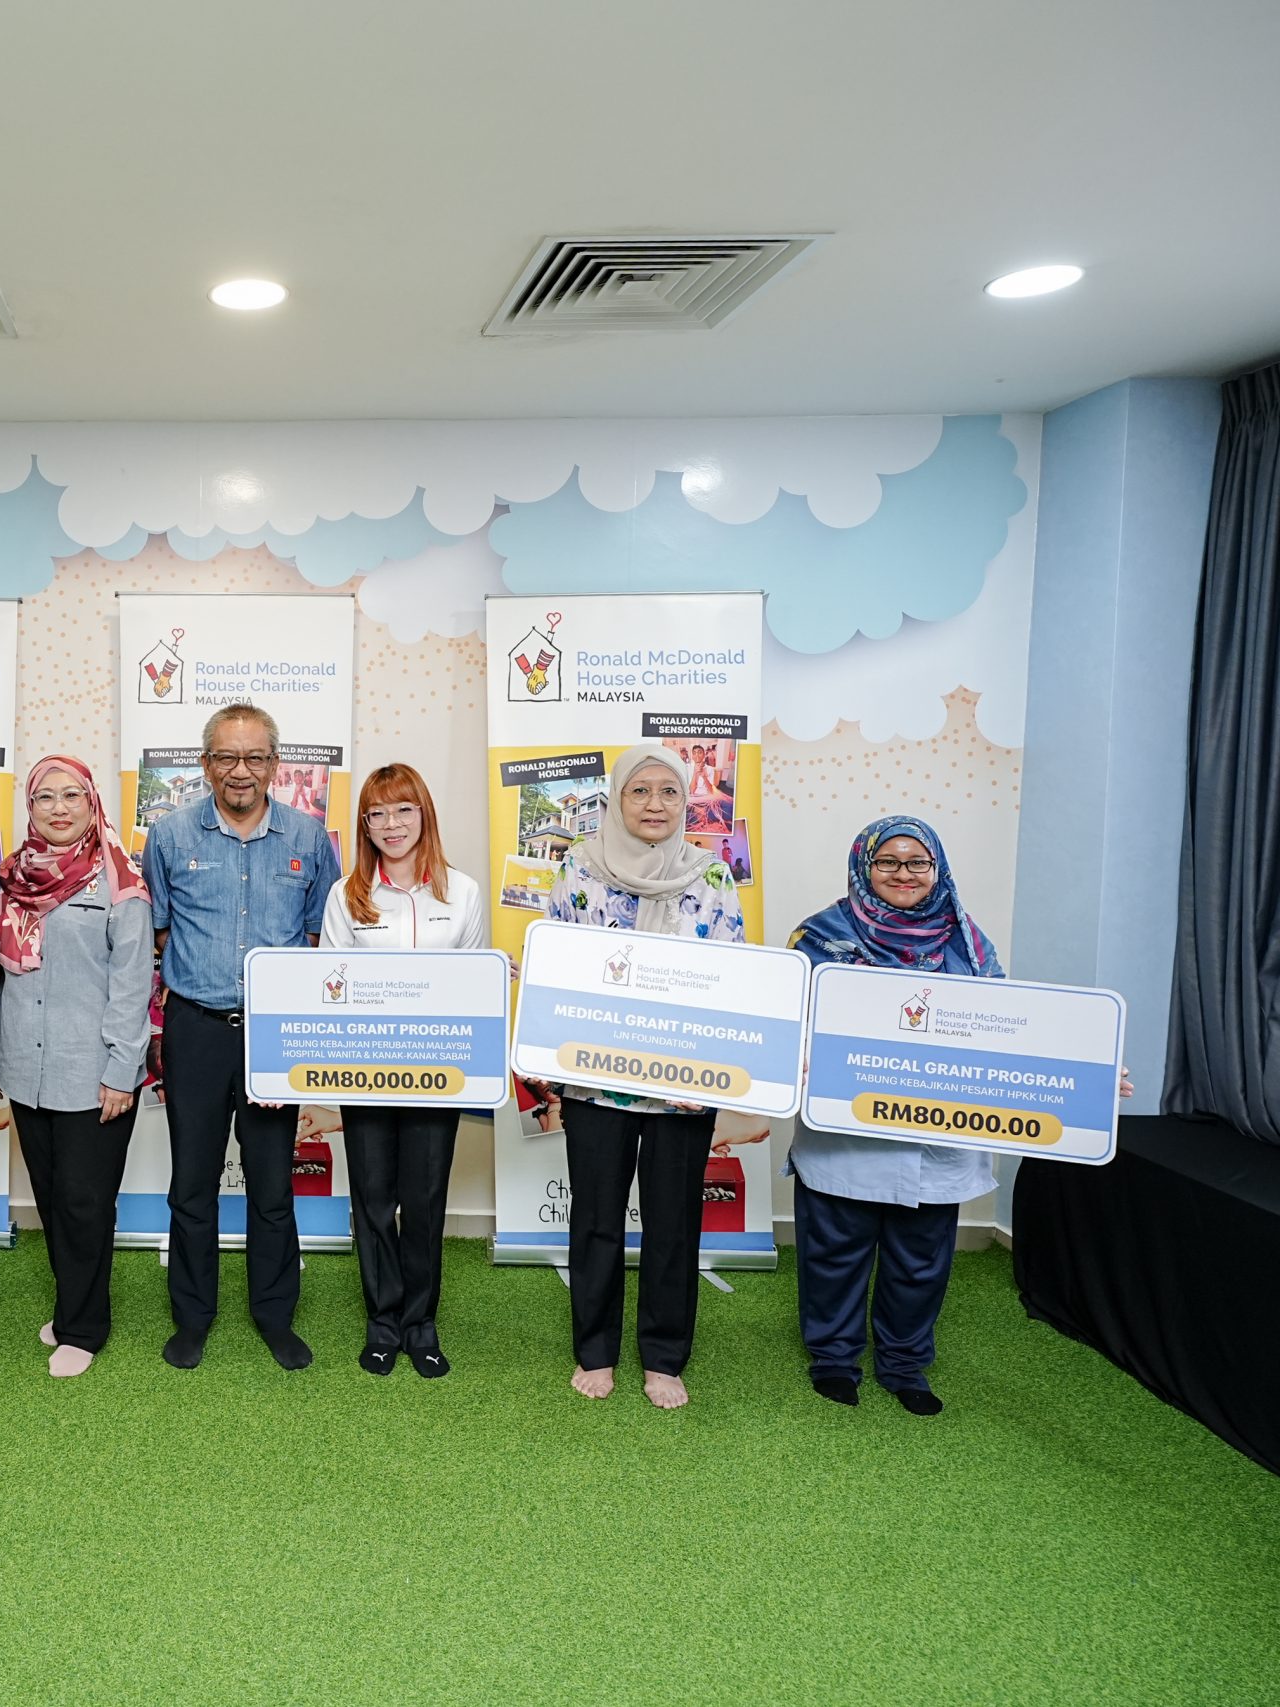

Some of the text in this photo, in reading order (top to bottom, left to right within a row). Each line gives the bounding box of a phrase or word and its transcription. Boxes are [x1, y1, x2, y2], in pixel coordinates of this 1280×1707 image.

[576, 648, 745, 667] Ronald McDonald
[195, 661, 336, 676] Ronald McDonald
[577, 669, 727, 686] House Charities
[195, 678, 323, 692] House Charities
[195, 695, 254, 707] MALAYSIA
[577, 691, 645, 702] MALAYSIA
[649, 716, 741, 726] RONALD McDONALD
[658, 725, 732, 735] SENSORY ROOM
[278, 753, 307, 761] ENSORY
[296, 747, 338, 756] McDONALD
[172, 757, 199, 765] HOUSE
[507, 756, 597, 774] RONALD McDONALD
[538, 767, 570, 779] HOUSE
[637, 963, 720, 982] Ronald McDonald
[352, 980, 430, 989] Ronald McDonald
[635, 982, 669, 992] MALAYSIA
[636, 973, 710, 990] House Charities
[352, 989, 423, 998] House Charities
[553, 1003, 763, 1044] MEDICAL GRANT PROGRAM
[936, 1008, 1027, 1026] Ronald McDonald
[280, 1022, 472, 1036] MEDICAL GRANT PROGRAM
[934, 1028, 972, 1038] MALAYSIA
[935, 1018, 1018, 1035] House Charities
[281, 1039, 472, 1050] TABUNG KEBAJIKAN PERUBATAN MALAYSIA
[613, 1029, 696, 1050] IJN FOUNDATION
[282, 1049, 471, 1060] HOSPITAL WANITA & KANAK-KANAK SABAH
[575, 1049, 731, 1090] RM80,000.00
[846, 1052, 1074, 1090] MEDICAL GRANT PROGRAM
[306, 1070, 447, 1091] RM80,000.00
[854, 1072, 1064, 1104] TABUNG KEBAJIKAN PESAKIT HPKK UKM
[872, 1100, 1041, 1138] RM80,000.00
